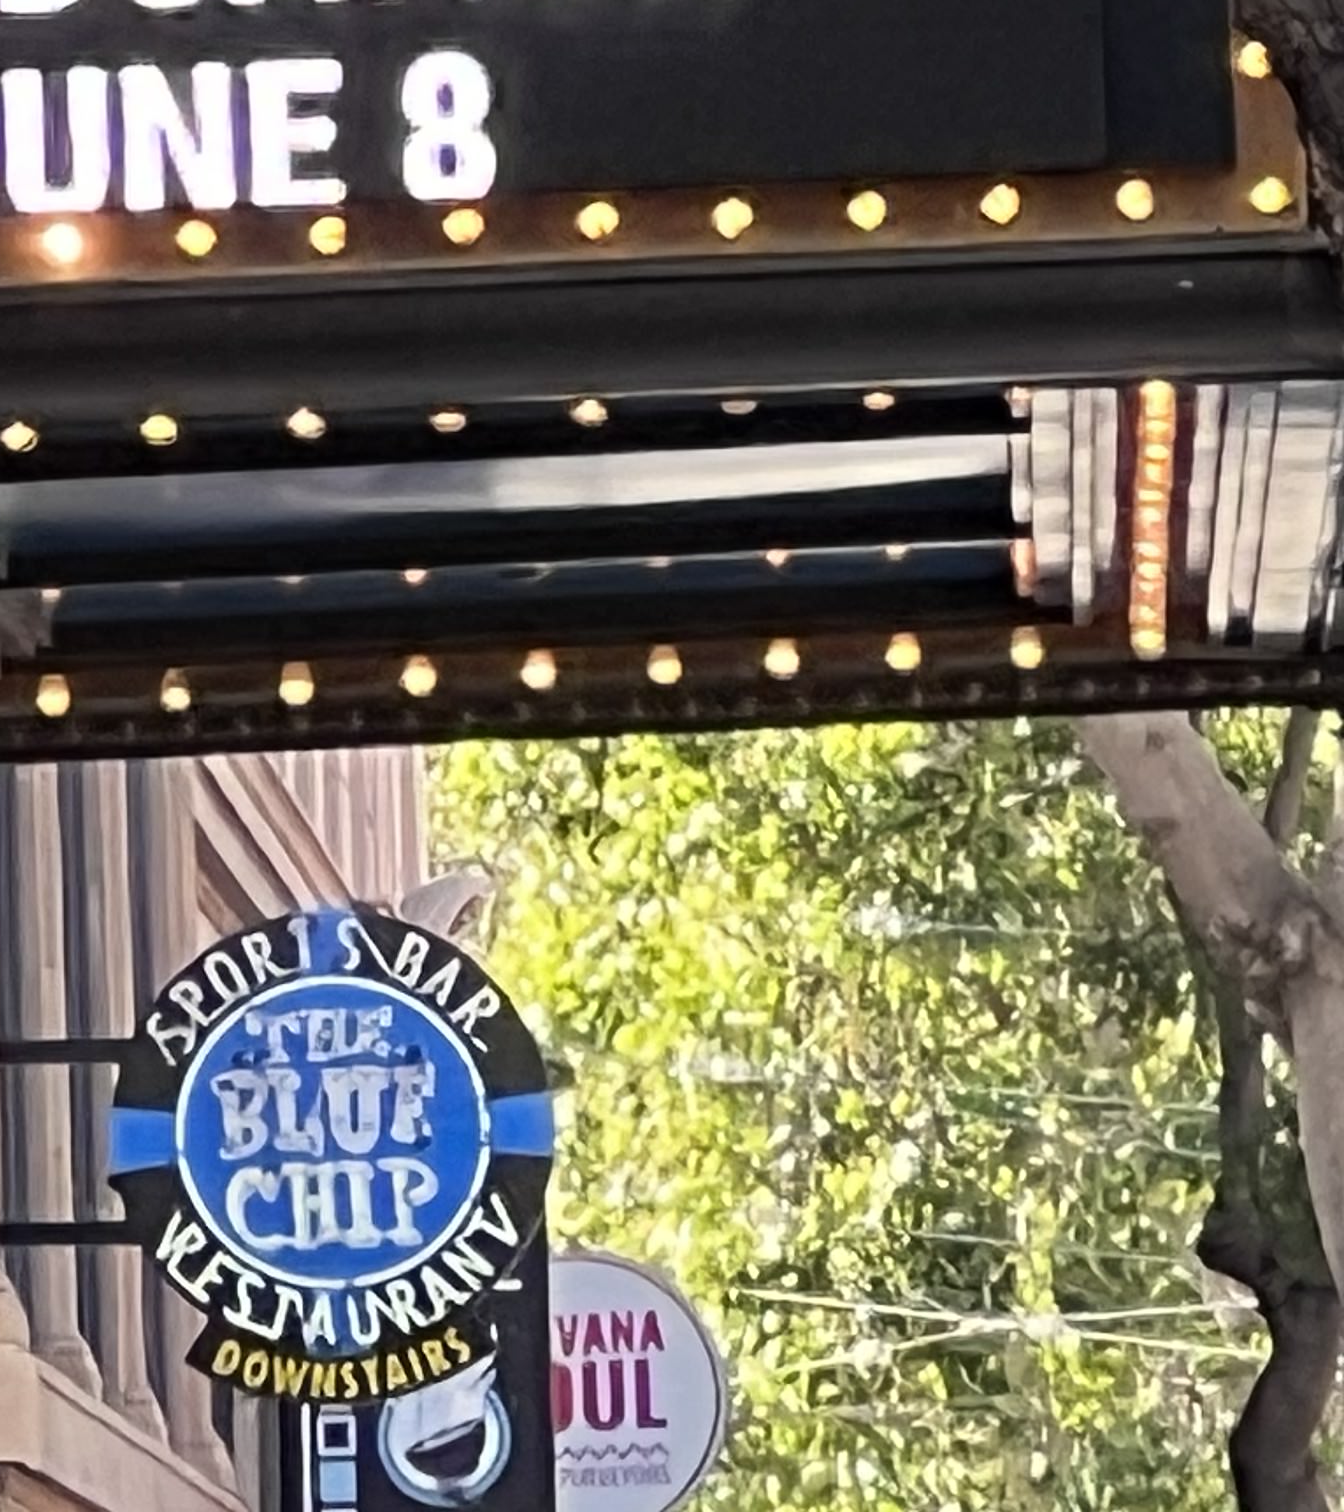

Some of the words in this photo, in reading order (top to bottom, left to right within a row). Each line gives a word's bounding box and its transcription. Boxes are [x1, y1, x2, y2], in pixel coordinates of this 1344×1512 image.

[400, 49, 498, 203] 8
[146, 916, 362, 1068] SPORTS
[393, 931, 502, 1054] BAR
[245, 1005, 394, 1064] THE
[210, 1063, 437, 1160] BLUE
[225, 1156, 439, 1249] CHIP
[156, 1192, 522, 1348] RESTAURANT
[212, 1325, 472, 1399] DOWNSTAIRS
